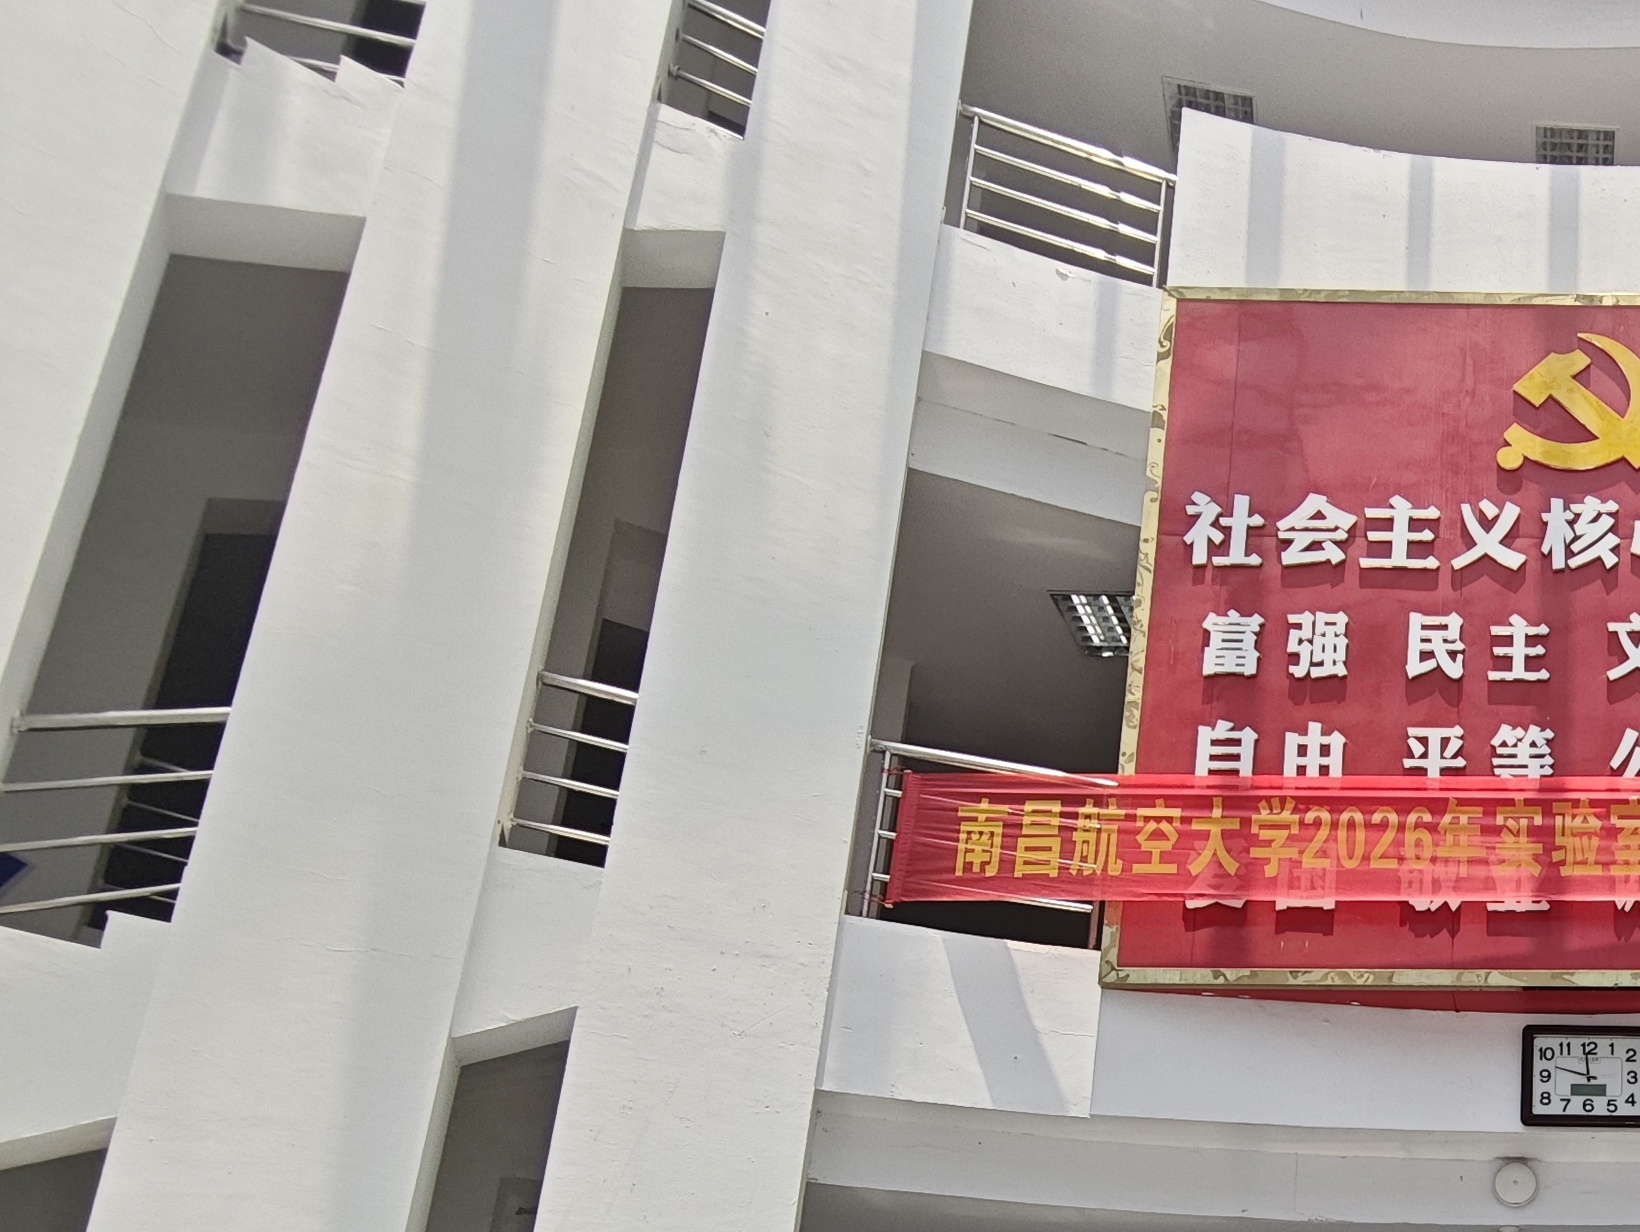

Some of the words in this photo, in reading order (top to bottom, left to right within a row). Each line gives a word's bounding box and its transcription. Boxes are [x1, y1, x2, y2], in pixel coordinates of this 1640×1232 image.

[1201, 611, 1349, 681] 富强
[1404, 614, 1551, 683] 民主
[1194, 719, 1348, 779] 自由
[1402, 724, 1555, 779] 平等
[1538, 1046, 1555, 1061] 10
[1559, 1041, 1571, 1056] 11
[1580, 1041, 1598, 1056] 12
[1608, 1042, 1614, 1056] 1
[1625, 1048, 1637, 1063] 2
[1539, 1069, 1551, 1083] 9
[1626, 1070, 1638, 1085] 3
[1540, 1091, 1551, 1106] 8
[1560, 1098, 1571, 1113] 7
[1582, 1098, 1595, 1113] 6
[1606, 1099, 1618, 1113] 5
[1624, 1092, 1637, 1107] 4
